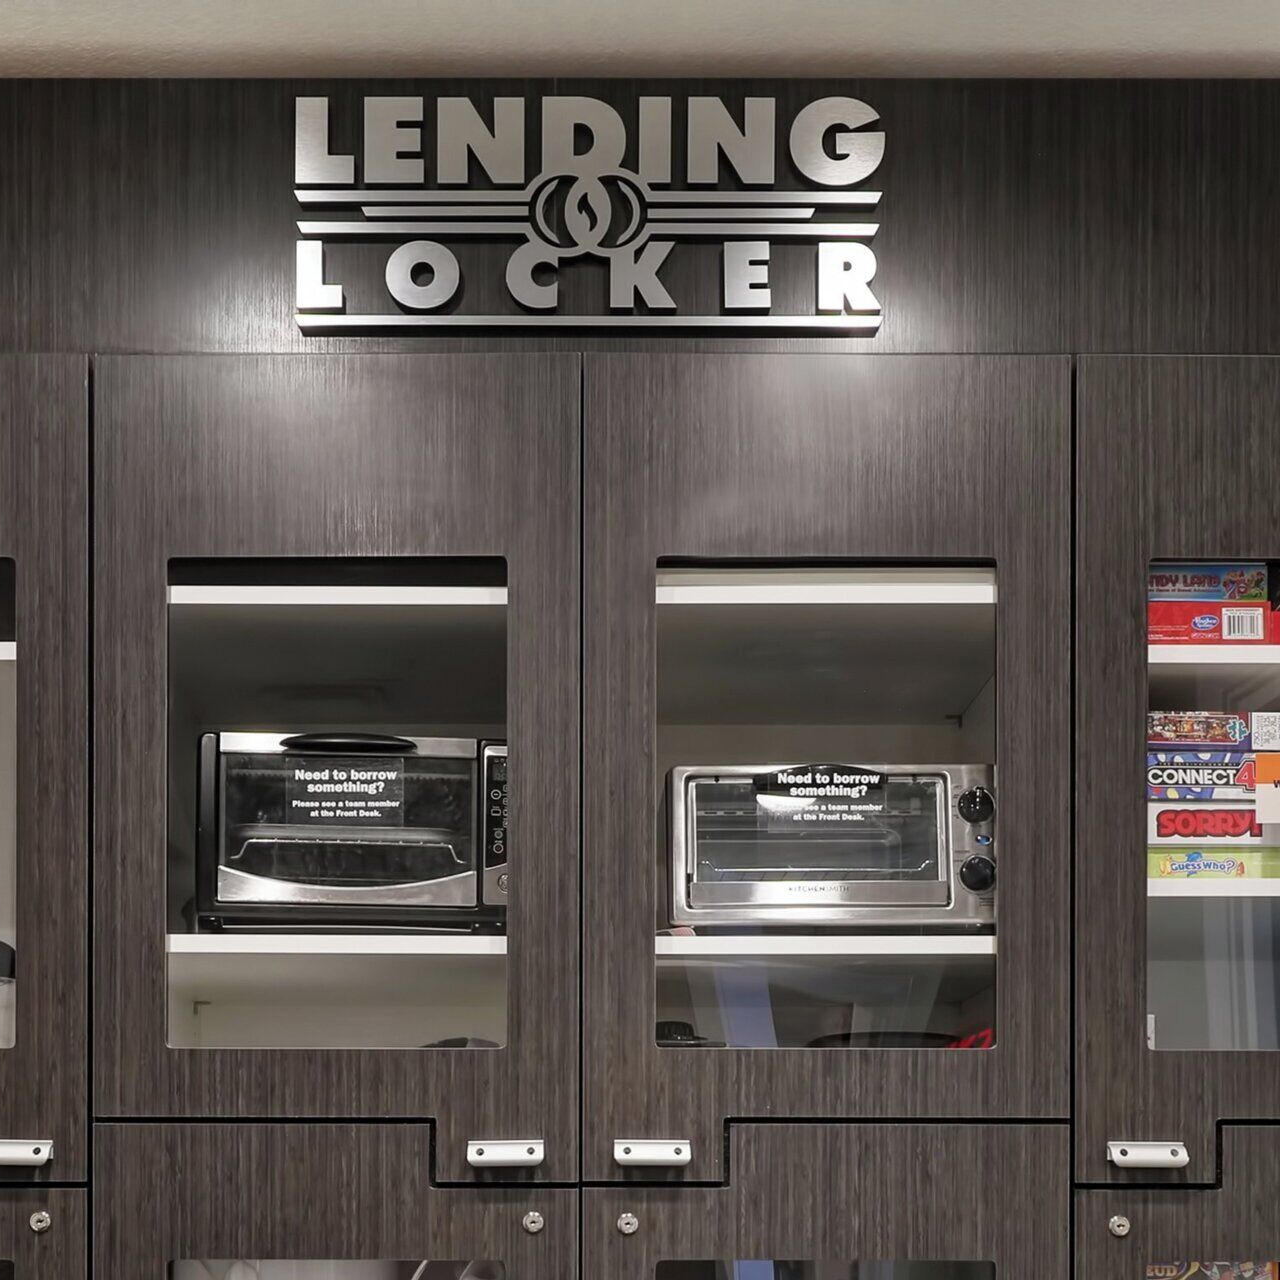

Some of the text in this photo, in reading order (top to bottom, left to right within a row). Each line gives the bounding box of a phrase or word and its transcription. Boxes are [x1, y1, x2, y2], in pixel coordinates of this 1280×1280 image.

[295, 96, 885, 186] LENDING
[295, 239, 882, 310] LOCKER
[295, 769, 398, 780] Need to borrow
[777, 773, 880, 784] Need to borrow
[1148, 761, 1256, 789] CONNECT 4
[307, 781, 385, 794] something?
[790, 785, 868, 798] something?
[1157, 809, 1262, 837] SORRY!
[1170, 860, 1235, 873] Guess Who?
